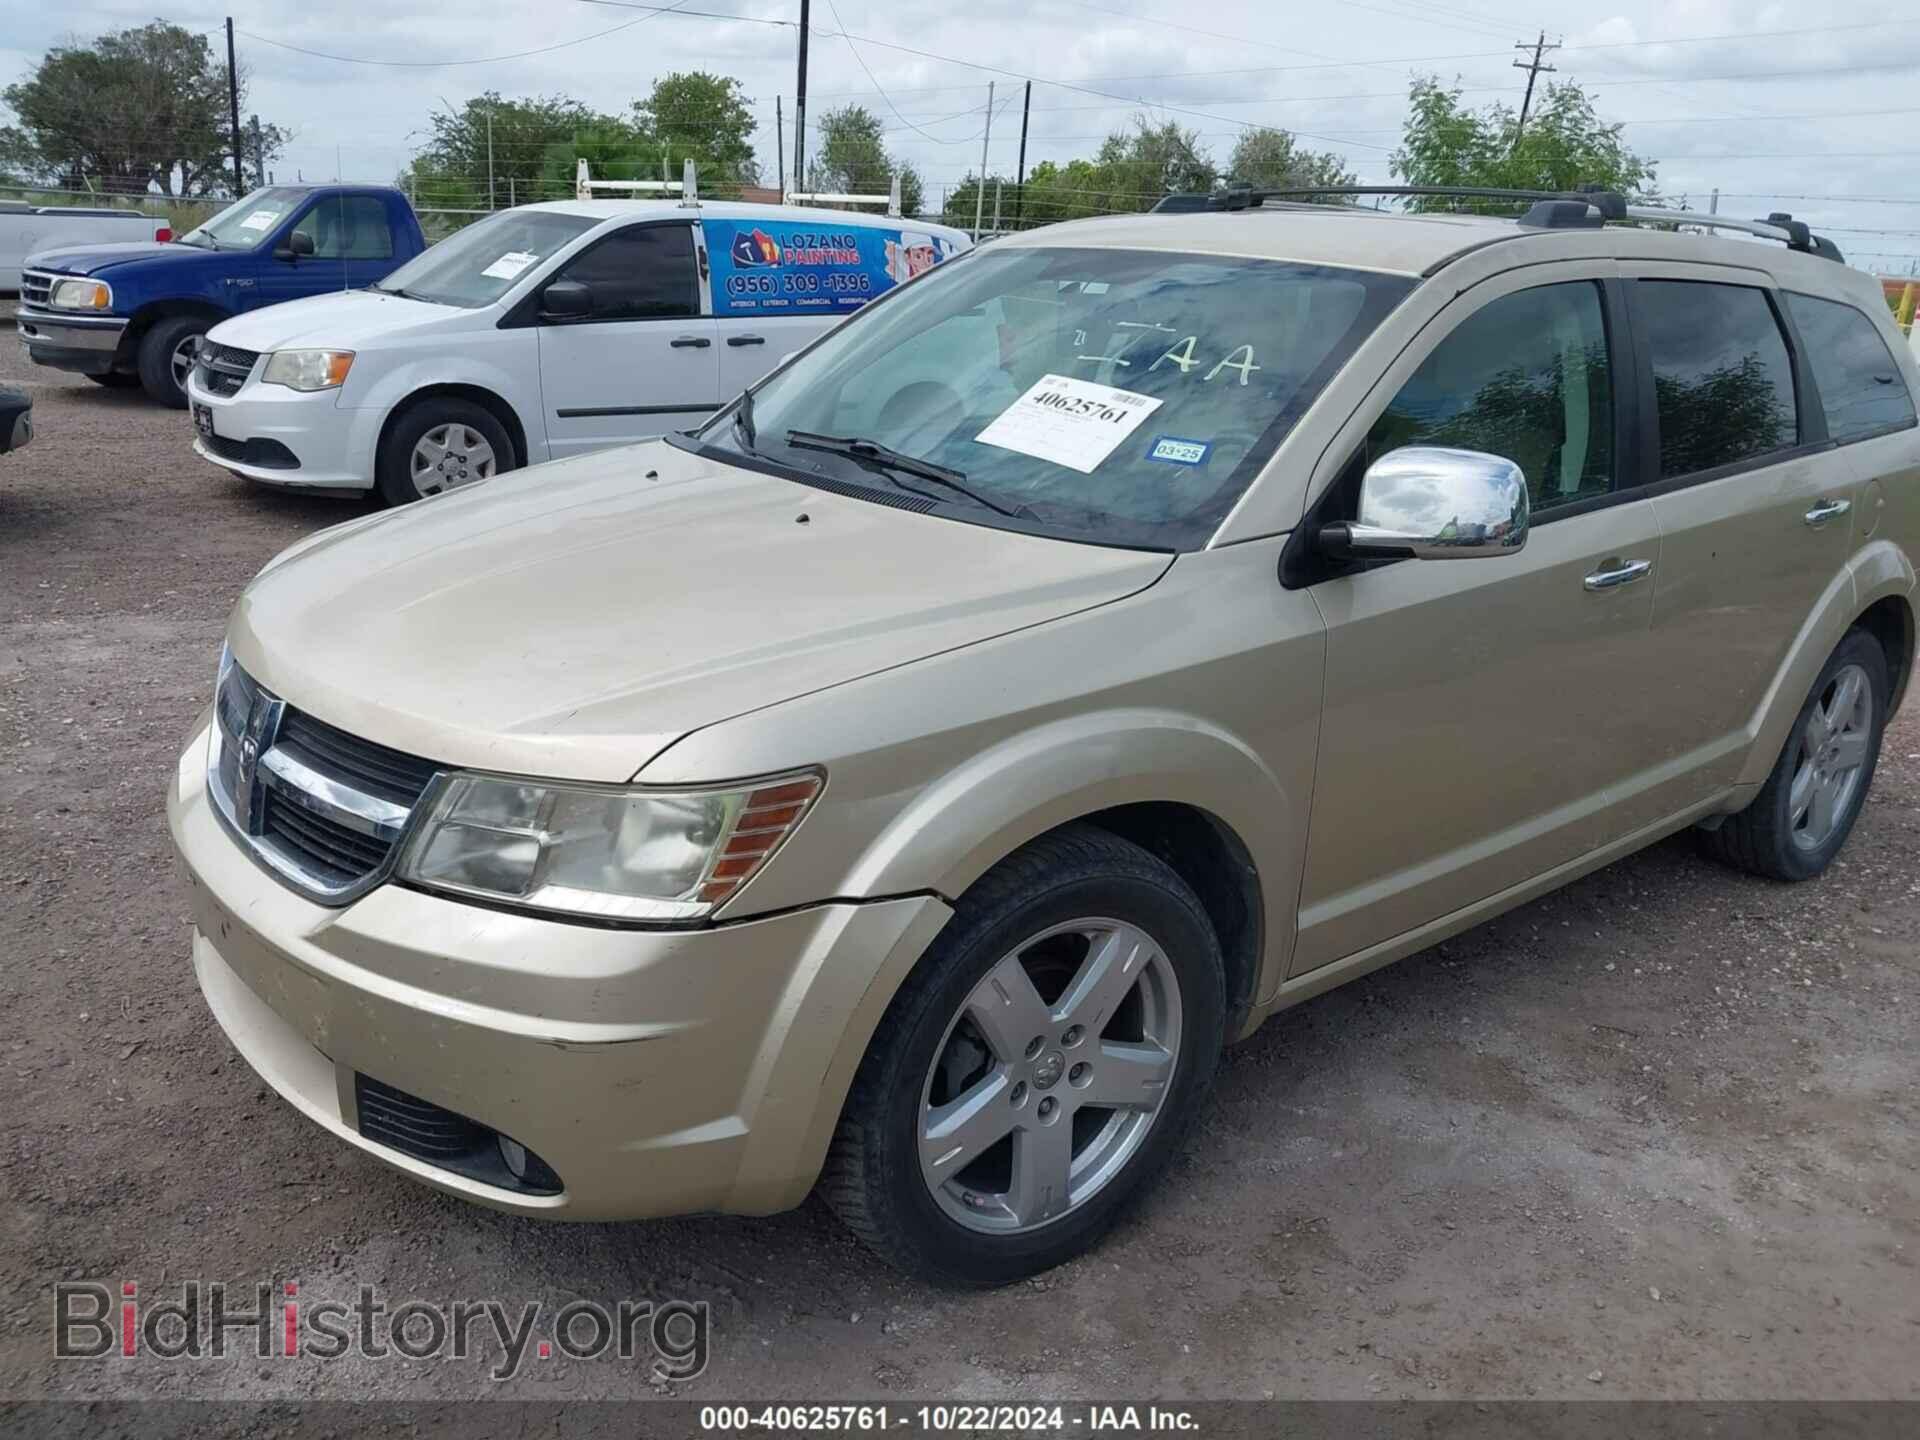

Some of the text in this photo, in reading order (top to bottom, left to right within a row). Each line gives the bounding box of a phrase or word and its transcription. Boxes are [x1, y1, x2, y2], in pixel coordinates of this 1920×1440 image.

[780, 233, 857, 249] LOZANO
[782, 247, 861, 265] PAINTING
[726, 273, 870, 297] (956) 309 -1396
[796, 297, 832, 306] COMMERCIAL
[1033, 391, 1129, 424] 40625761
